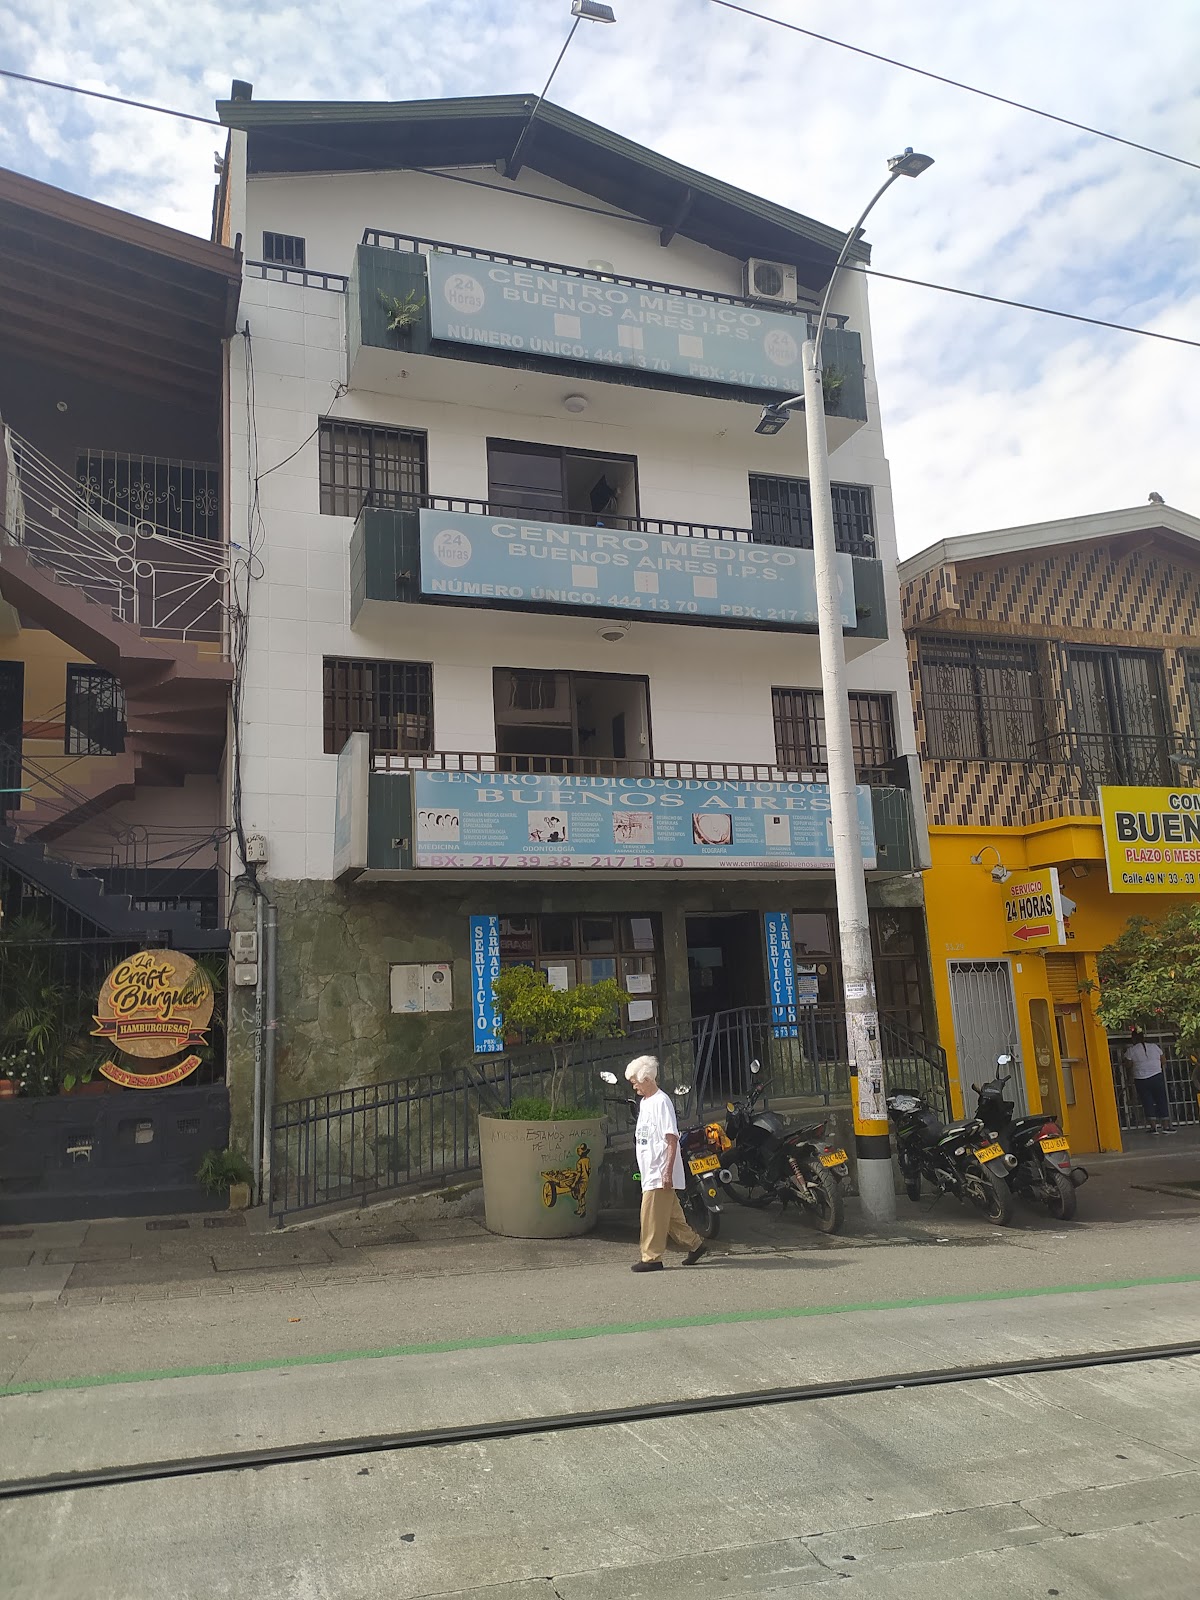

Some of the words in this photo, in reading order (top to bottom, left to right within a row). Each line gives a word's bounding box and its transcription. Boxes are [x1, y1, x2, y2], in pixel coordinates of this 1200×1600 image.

[454, 277, 474, 291] 24
[450, 290, 482, 308] Horas
[488, 268, 629, 304] CENTRO
[640, 294, 762, 326] MÉDICO
[503, 287, 613, 317] BUENOS
[620, 308, 694, 331] AIRES
[703, 322, 756, 341] I.P.S.
[447, 323, 524, 348] NÚMERO
[530, 335, 589, 359] ÚNICO:
[594, 348, 624, 364] 444
[652, 358, 670, 372] 70
[688, 362, 724, 380] PBX:
[729, 370, 756, 384] 217
[761, 374, 778, 388] 39
[783, 378, 800, 391] 38
[442, 533, 462, 546] 24
[491, 523, 649, 552] CENTRO
[661, 542, 796, 566] MÉDICO
[438, 546, 469, 560] Horas
[508, 543, 629, 566] BUENOS
[636, 556, 718, 575] AIRES
[727, 564, 785, 581] I.P.S.
[432, 578, 524, 598] NÚMERO
[530, 586, 601, 605] ÚNICO:
[608, 594, 642, 608] 444
[648, 598, 670, 611] 13
[676, 600, 698, 613] 70
[720, 604, 762, 618] PBX:
[767, 608, 798, 622] 217
[426, 772, 542, 786] CENTRO
[474, 788, 685, 807] BUENOS
[699, 795, 831, 811] AIRES
[1115, 812, 1200, 842] BUEN
[418, 855, 464, 867] PBX:
[472, 856, 510, 868] 217
[516, 856, 540, 868] 39
[547, 856, 572, 868] 38
[591, 856, 626, 868] 217
[633, 856, 655, 868] 13
[662, 857, 684, 868] 70
[1125, 849, 1161, 862] PLAZO
[1164, 850, 1171, 862] 6
[1010, 881, 1042, 896] SERVICIO
[1122, 873, 1142, 884] Calle
[1145, 873, 1154, 884] 49
[1168, 874, 1178, 884] 33
[1185, 874, 1194, 884] 33
[1006, 900, 1017, 921] 24
[1019, 894, 1052, 920] HORAS
[135, 956, 153, 969] La
[768, 921, 784, 1016] SERVICIO
[780, 913, 796, 1022] FARMACEUTICO
[114, 965, 173, 990] Craft
[474, 926, 488, 1030] SERVICIO
[113, 984, 205, 1018] Burguer
[120, 1023, 188, 1034] HAMBURGUESAS
[476, 1044, 487, 1052] 217
[102, 1056, 199, 1087] ARTESANALES
